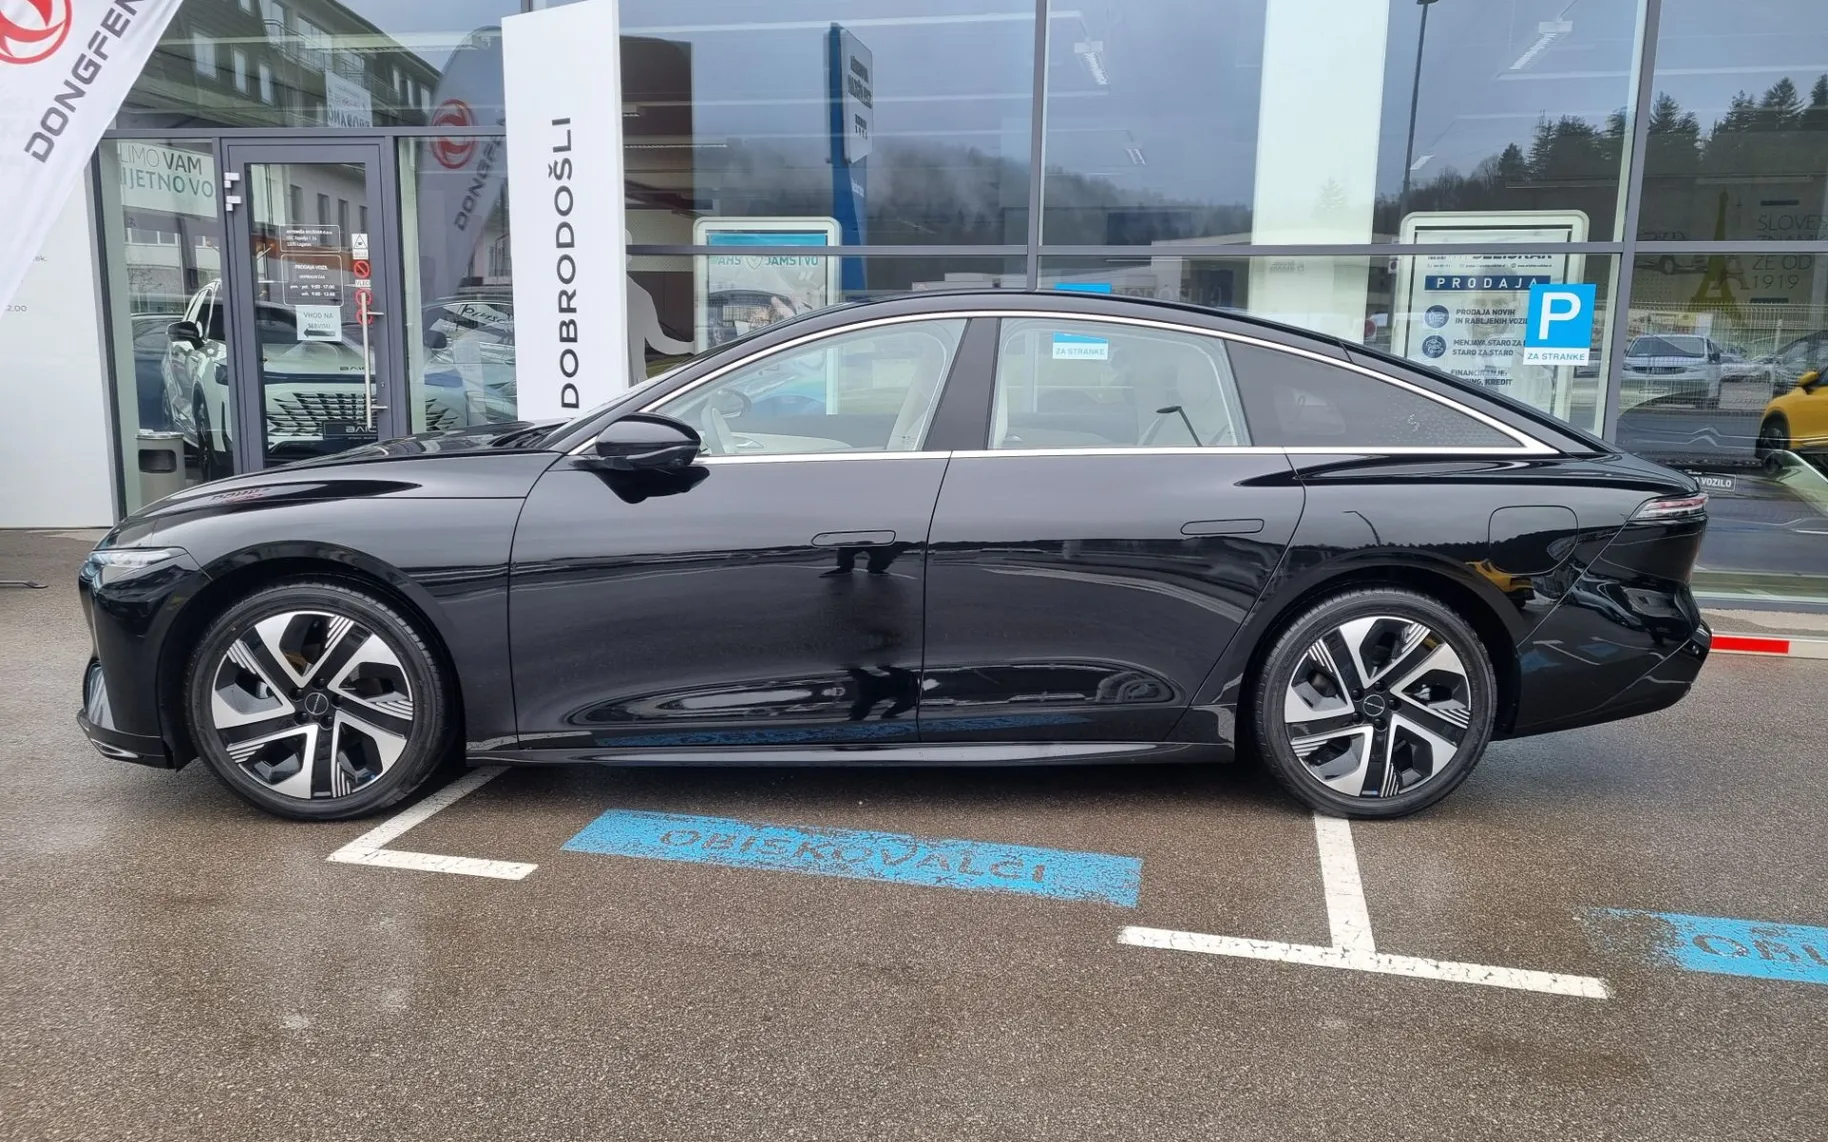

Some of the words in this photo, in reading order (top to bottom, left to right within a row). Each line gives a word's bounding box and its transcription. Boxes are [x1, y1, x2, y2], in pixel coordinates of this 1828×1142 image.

[163, 151, 202, 175] VAM
[548, 117, 580, 410] DOBRODOŠLI
[1782, 254, 1812, 271] OD
[1436, 277, 1538, 289] PRODAJA
[1752, 275, 1800, 289] 1919
[303, 311, 323, 319] VHOD
[1455, 308, 1491, 316] PRODAJA
[1492, 308, 1516, 316] NOVIH
[1538, 291, 1582, 340] P
[1455, 317, 1463, 325] IN
[1464, 317, 1508, 325] RABLJENIH
[1487, 339, 1511, 347] STARO
[1056, 347, 1066, 356] ZA
[1068, 347, 1105, 356] STRANKE
[1527, 352, 1539, 360] ZA
[1541, 352, 1585, 361] STRANKE
[1484, 378, 1512, 386] KREDIT
[1701, 477, 1732, 488] VOZILO
